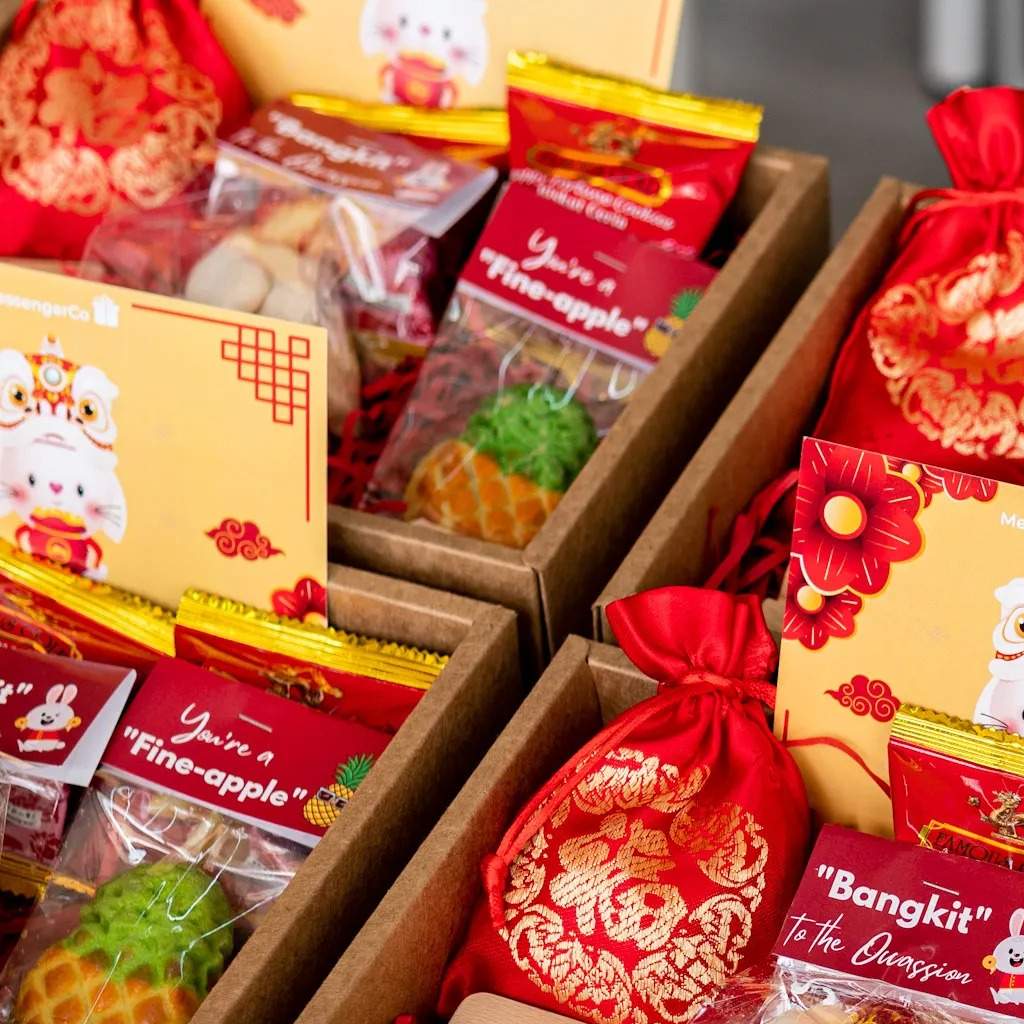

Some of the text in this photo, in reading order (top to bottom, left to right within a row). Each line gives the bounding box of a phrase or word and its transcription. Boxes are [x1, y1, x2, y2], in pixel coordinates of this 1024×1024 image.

[123, 726, 309, 807] "Fine-apple"
[170, 703, 275, 767] You're a
[783, 912, 816, 946] to
[808, 913, 845, 953] the
[817, 864, 993, 935] "Bangkit"
